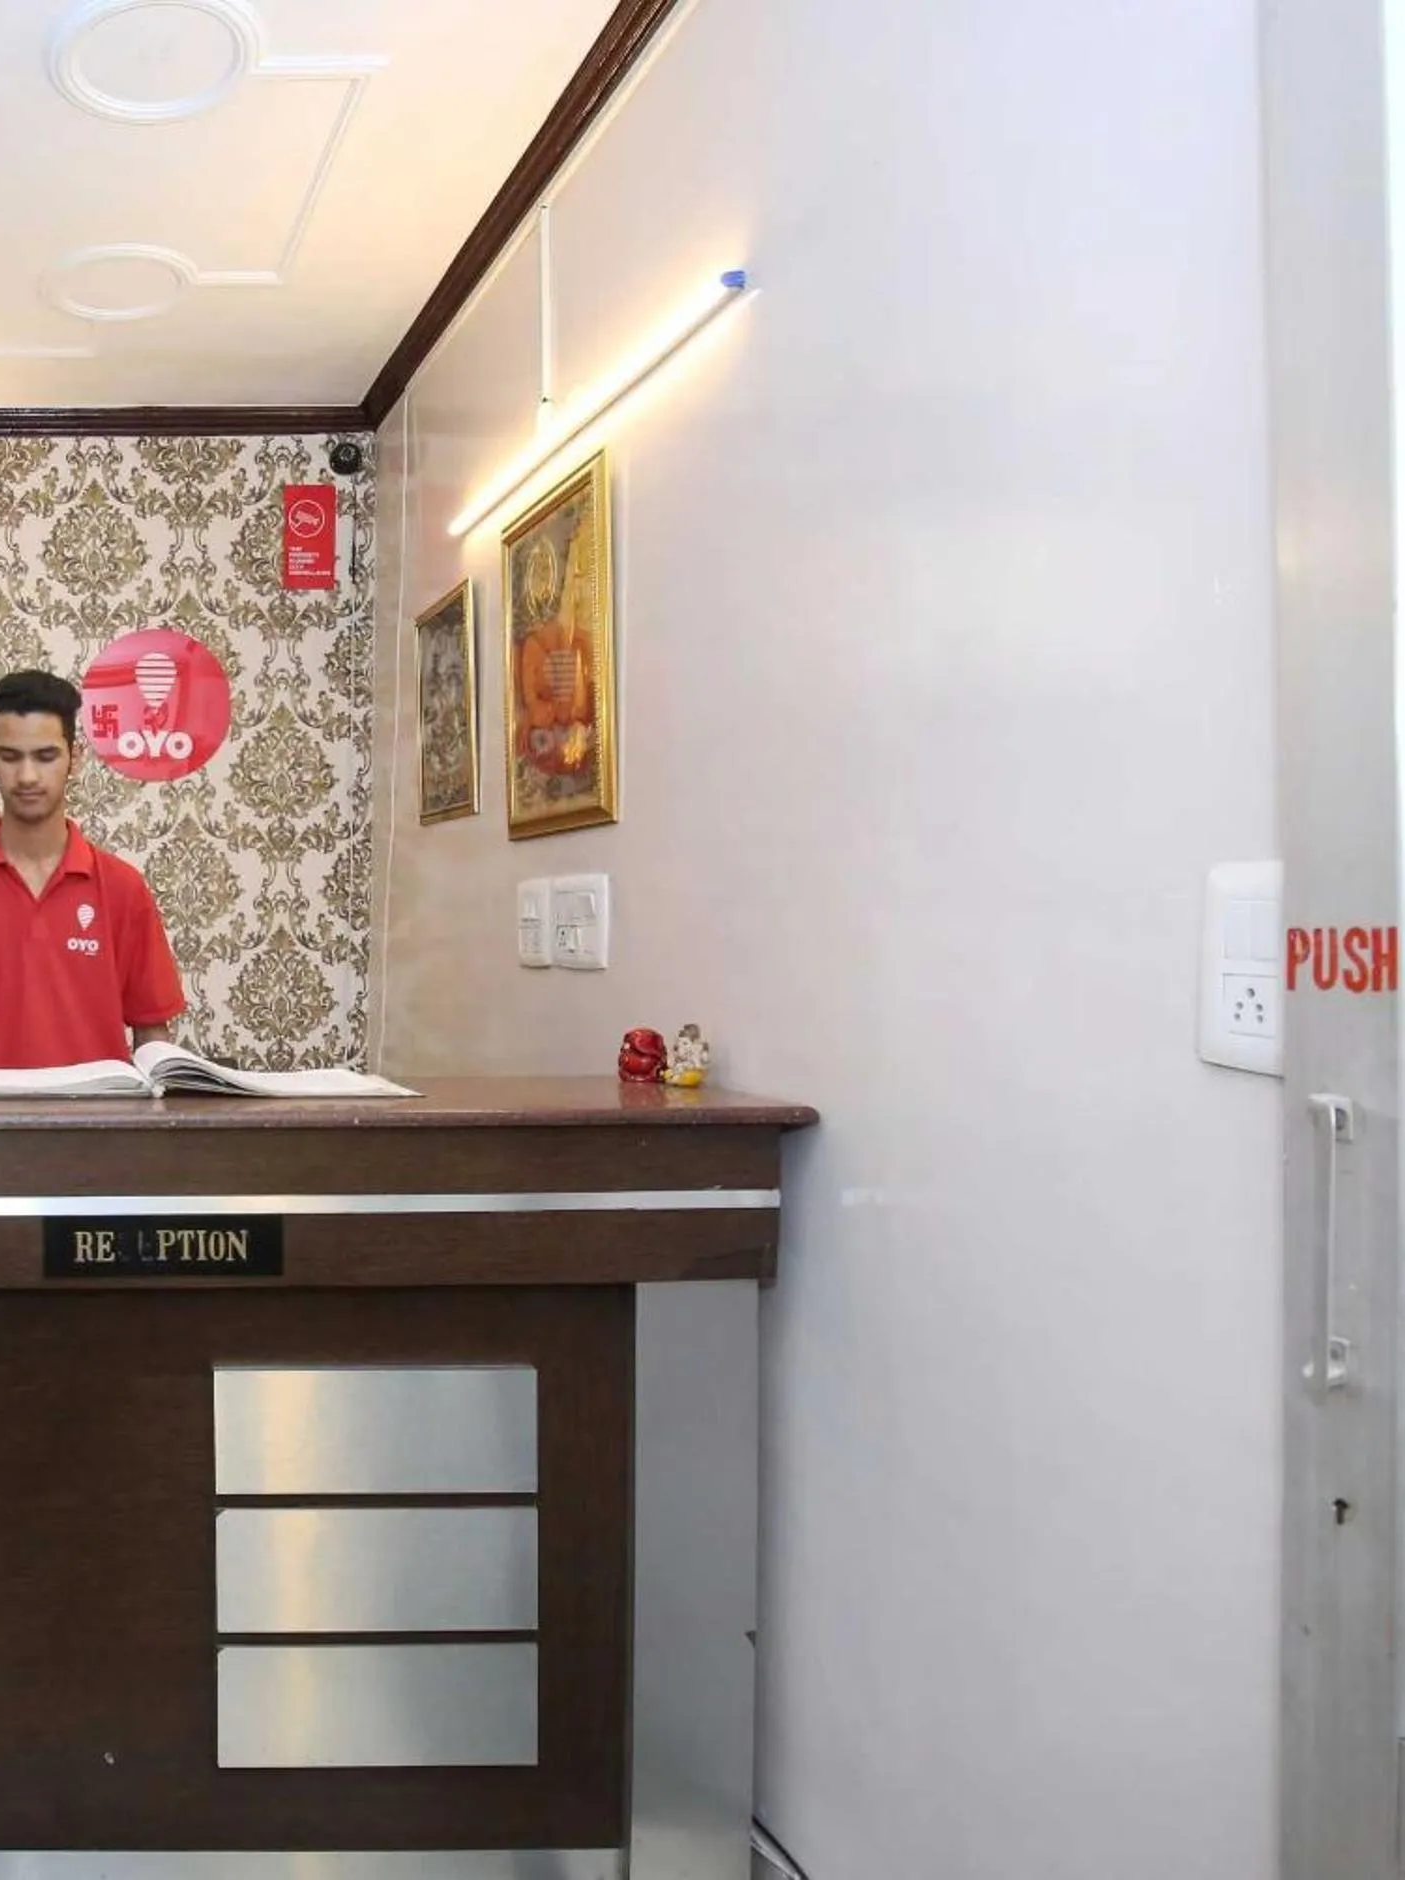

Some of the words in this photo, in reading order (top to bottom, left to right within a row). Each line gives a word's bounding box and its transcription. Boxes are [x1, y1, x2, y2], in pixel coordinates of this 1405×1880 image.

[117, 729, 194, 760] OYO
[67, 937, 99, 952] OYO
[1286, 926, 1398, 993] PUSH
[73, 1229, 249, 1263] REPTION
